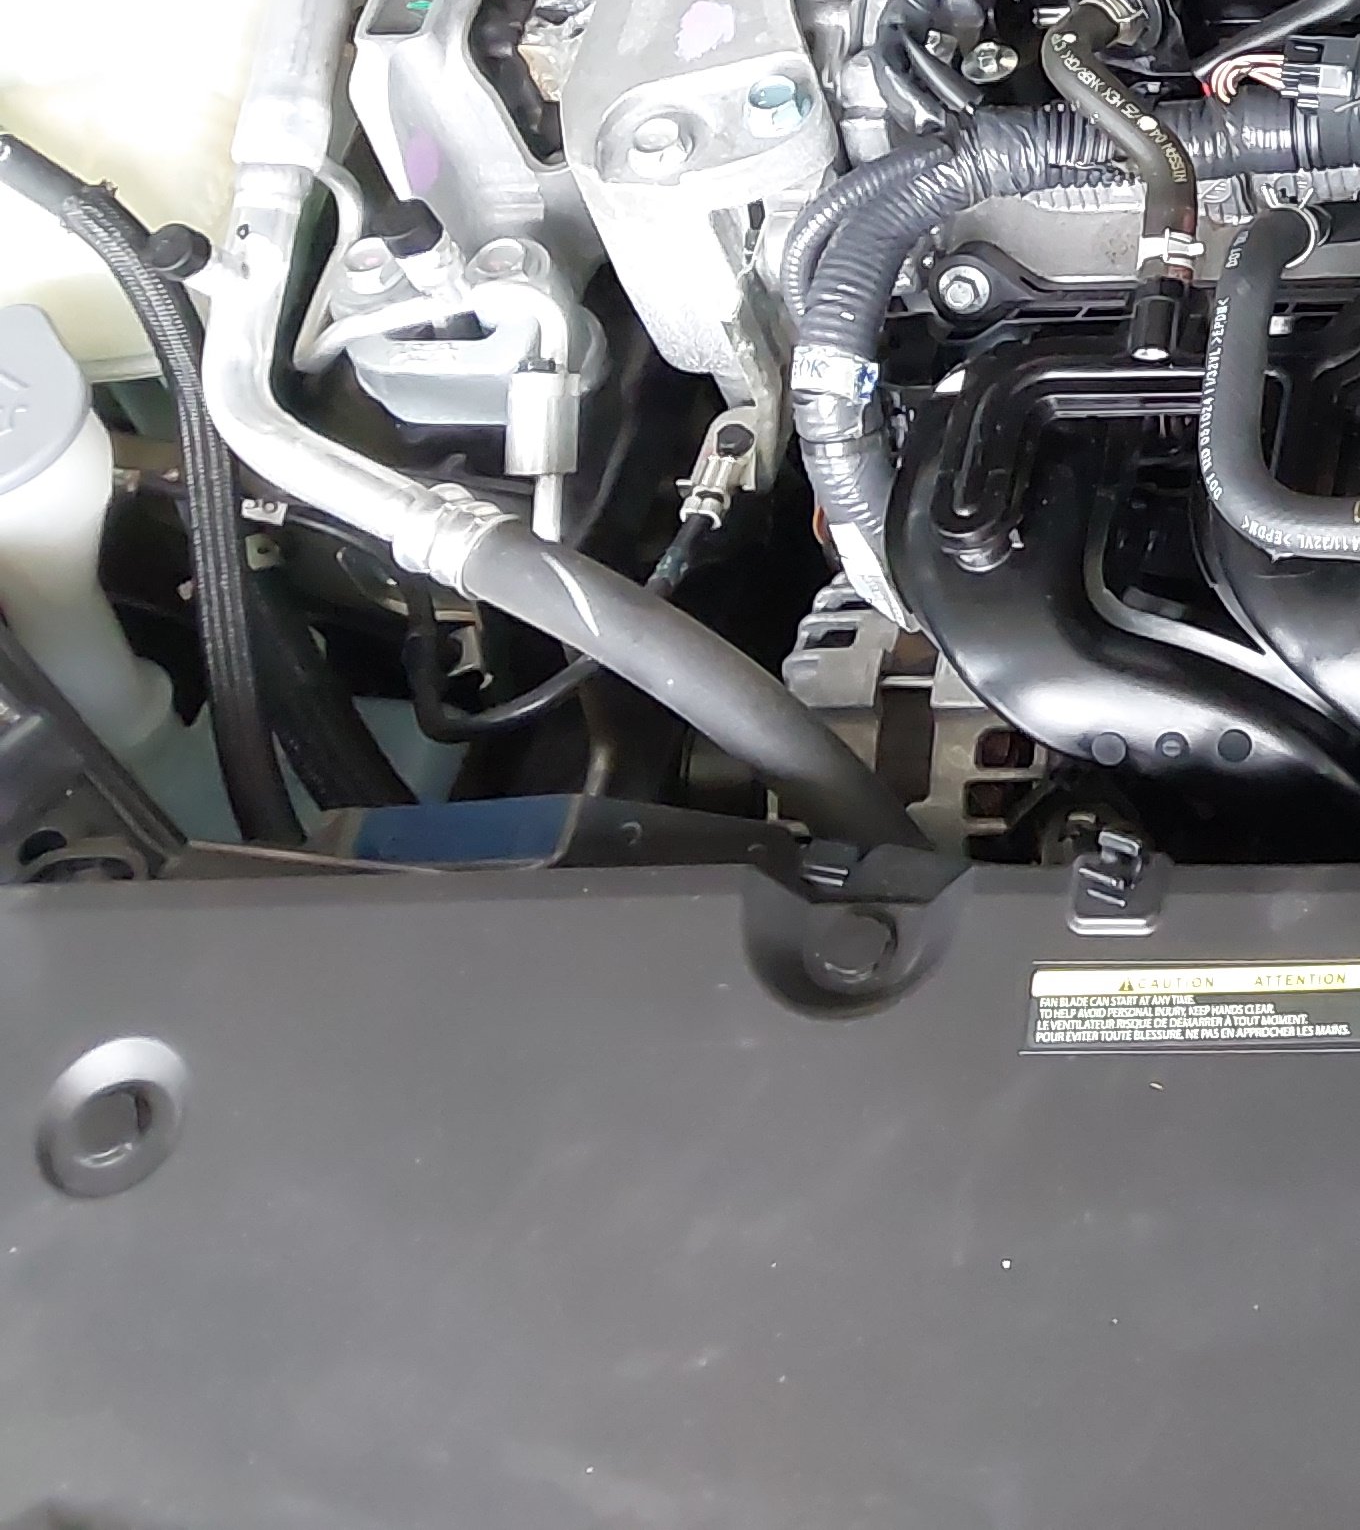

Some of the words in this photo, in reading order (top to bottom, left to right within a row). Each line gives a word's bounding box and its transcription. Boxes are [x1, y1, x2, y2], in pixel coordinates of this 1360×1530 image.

[1206, 472, 1223, 501] DOT
[1138, 976, 1215, 990] CAUTION
[1254, 973, 1346, 987] ATTENTION
[1040, 996, 1058, 1008] FAN
[1060, 996, 1089, 1007] BLADE
[1090, 996, 1109, 1007] CAN
[1110, 996, 1138, 1007] START
[1139, 995, 1152, 1006] AT
[1152, 995, 1171, 1006] ANY
[1040, 1009, 1053, 1019] TO
[1054, 1008, 1077, 1019] HELP
[1107, 1007, 1153, 1018] PERSONAL
[1188, 1006, 1210, 1016] KEEP
[1211, 1005, 1243, 1016] HANDS
[1050, 1019, 1115, 1031] VENTILATEUR
[1117, 1018, 1152, 1030] RISQUE
[1153, 1018, 1168, 1029] DE
[1233, 1016, 1259, 1027] TOUT
[1035, 1032, 1065, 1043] POUR
[1100, 1031, 1132, 1042] TOUTE
[1185, 1030, 1200, 1040] NE
[1200, 1028, 1219, 1039] PAS
[1221, 1028, 1235, 1039] EN
[1297, 1026, 1315, 1037] LES
